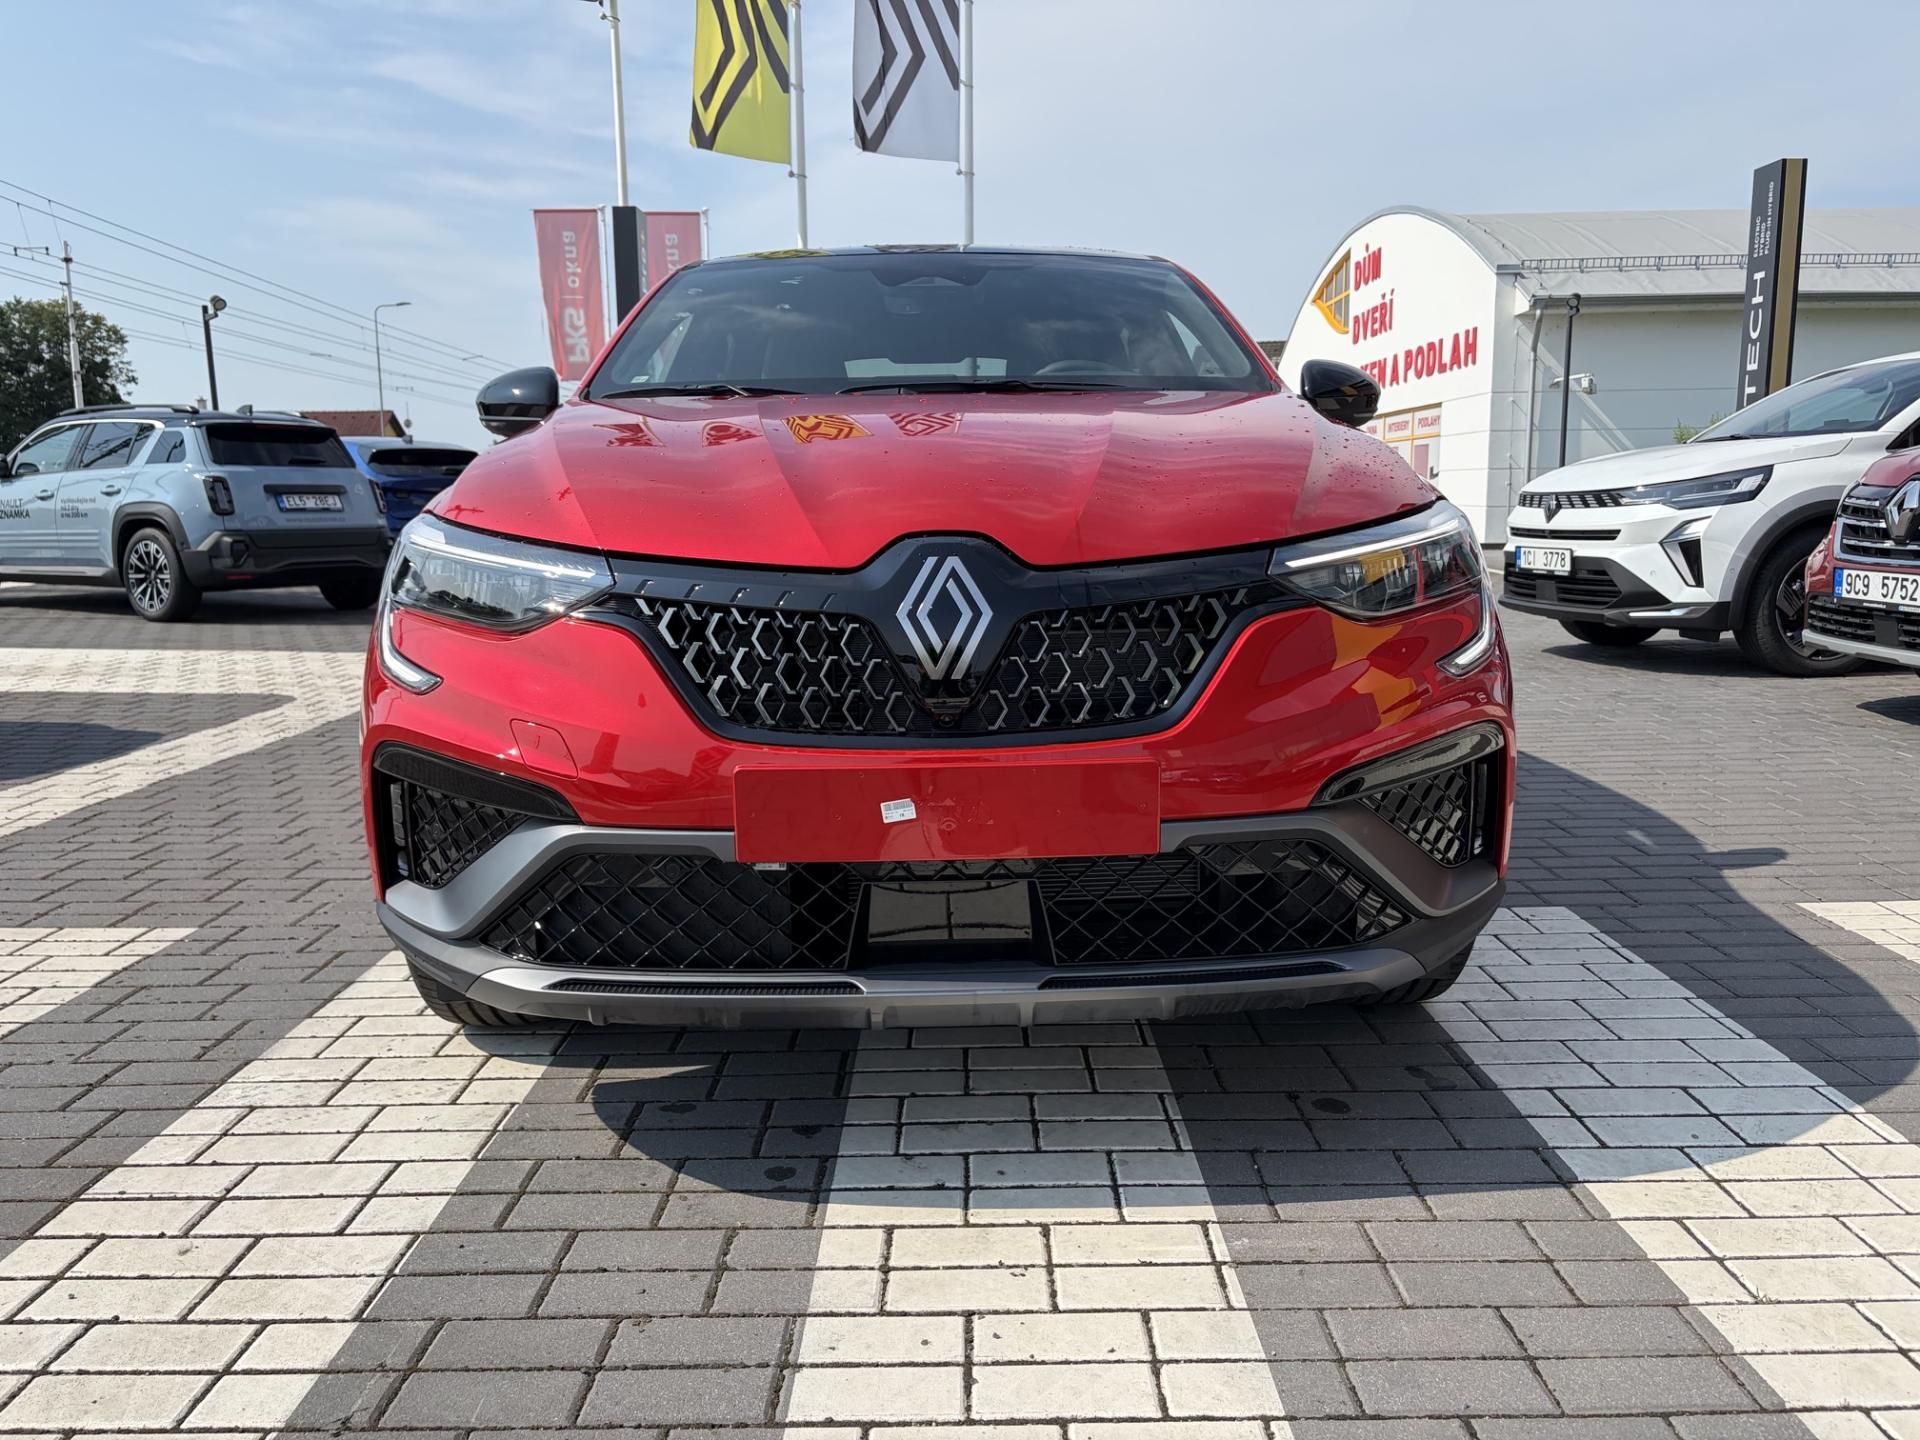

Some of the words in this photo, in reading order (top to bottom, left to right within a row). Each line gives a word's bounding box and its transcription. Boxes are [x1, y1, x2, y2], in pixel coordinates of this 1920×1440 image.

[1753, 215, 1761, 258] ELECTRIC
[1354, 242, 1382, 292] DŮM
[1352, 287, 1395, 345] DVEŘÍ
[1743, 270, 1766, 408] TECH
[1389, 353, 1400, 387] A
[1403, 326, 1478, 384] PODLAH
[1543, 551, 1566, 568] 3778
[1845, 573, 1870, 597] 9C9
[1880, 576, 1920, 602] 5752
